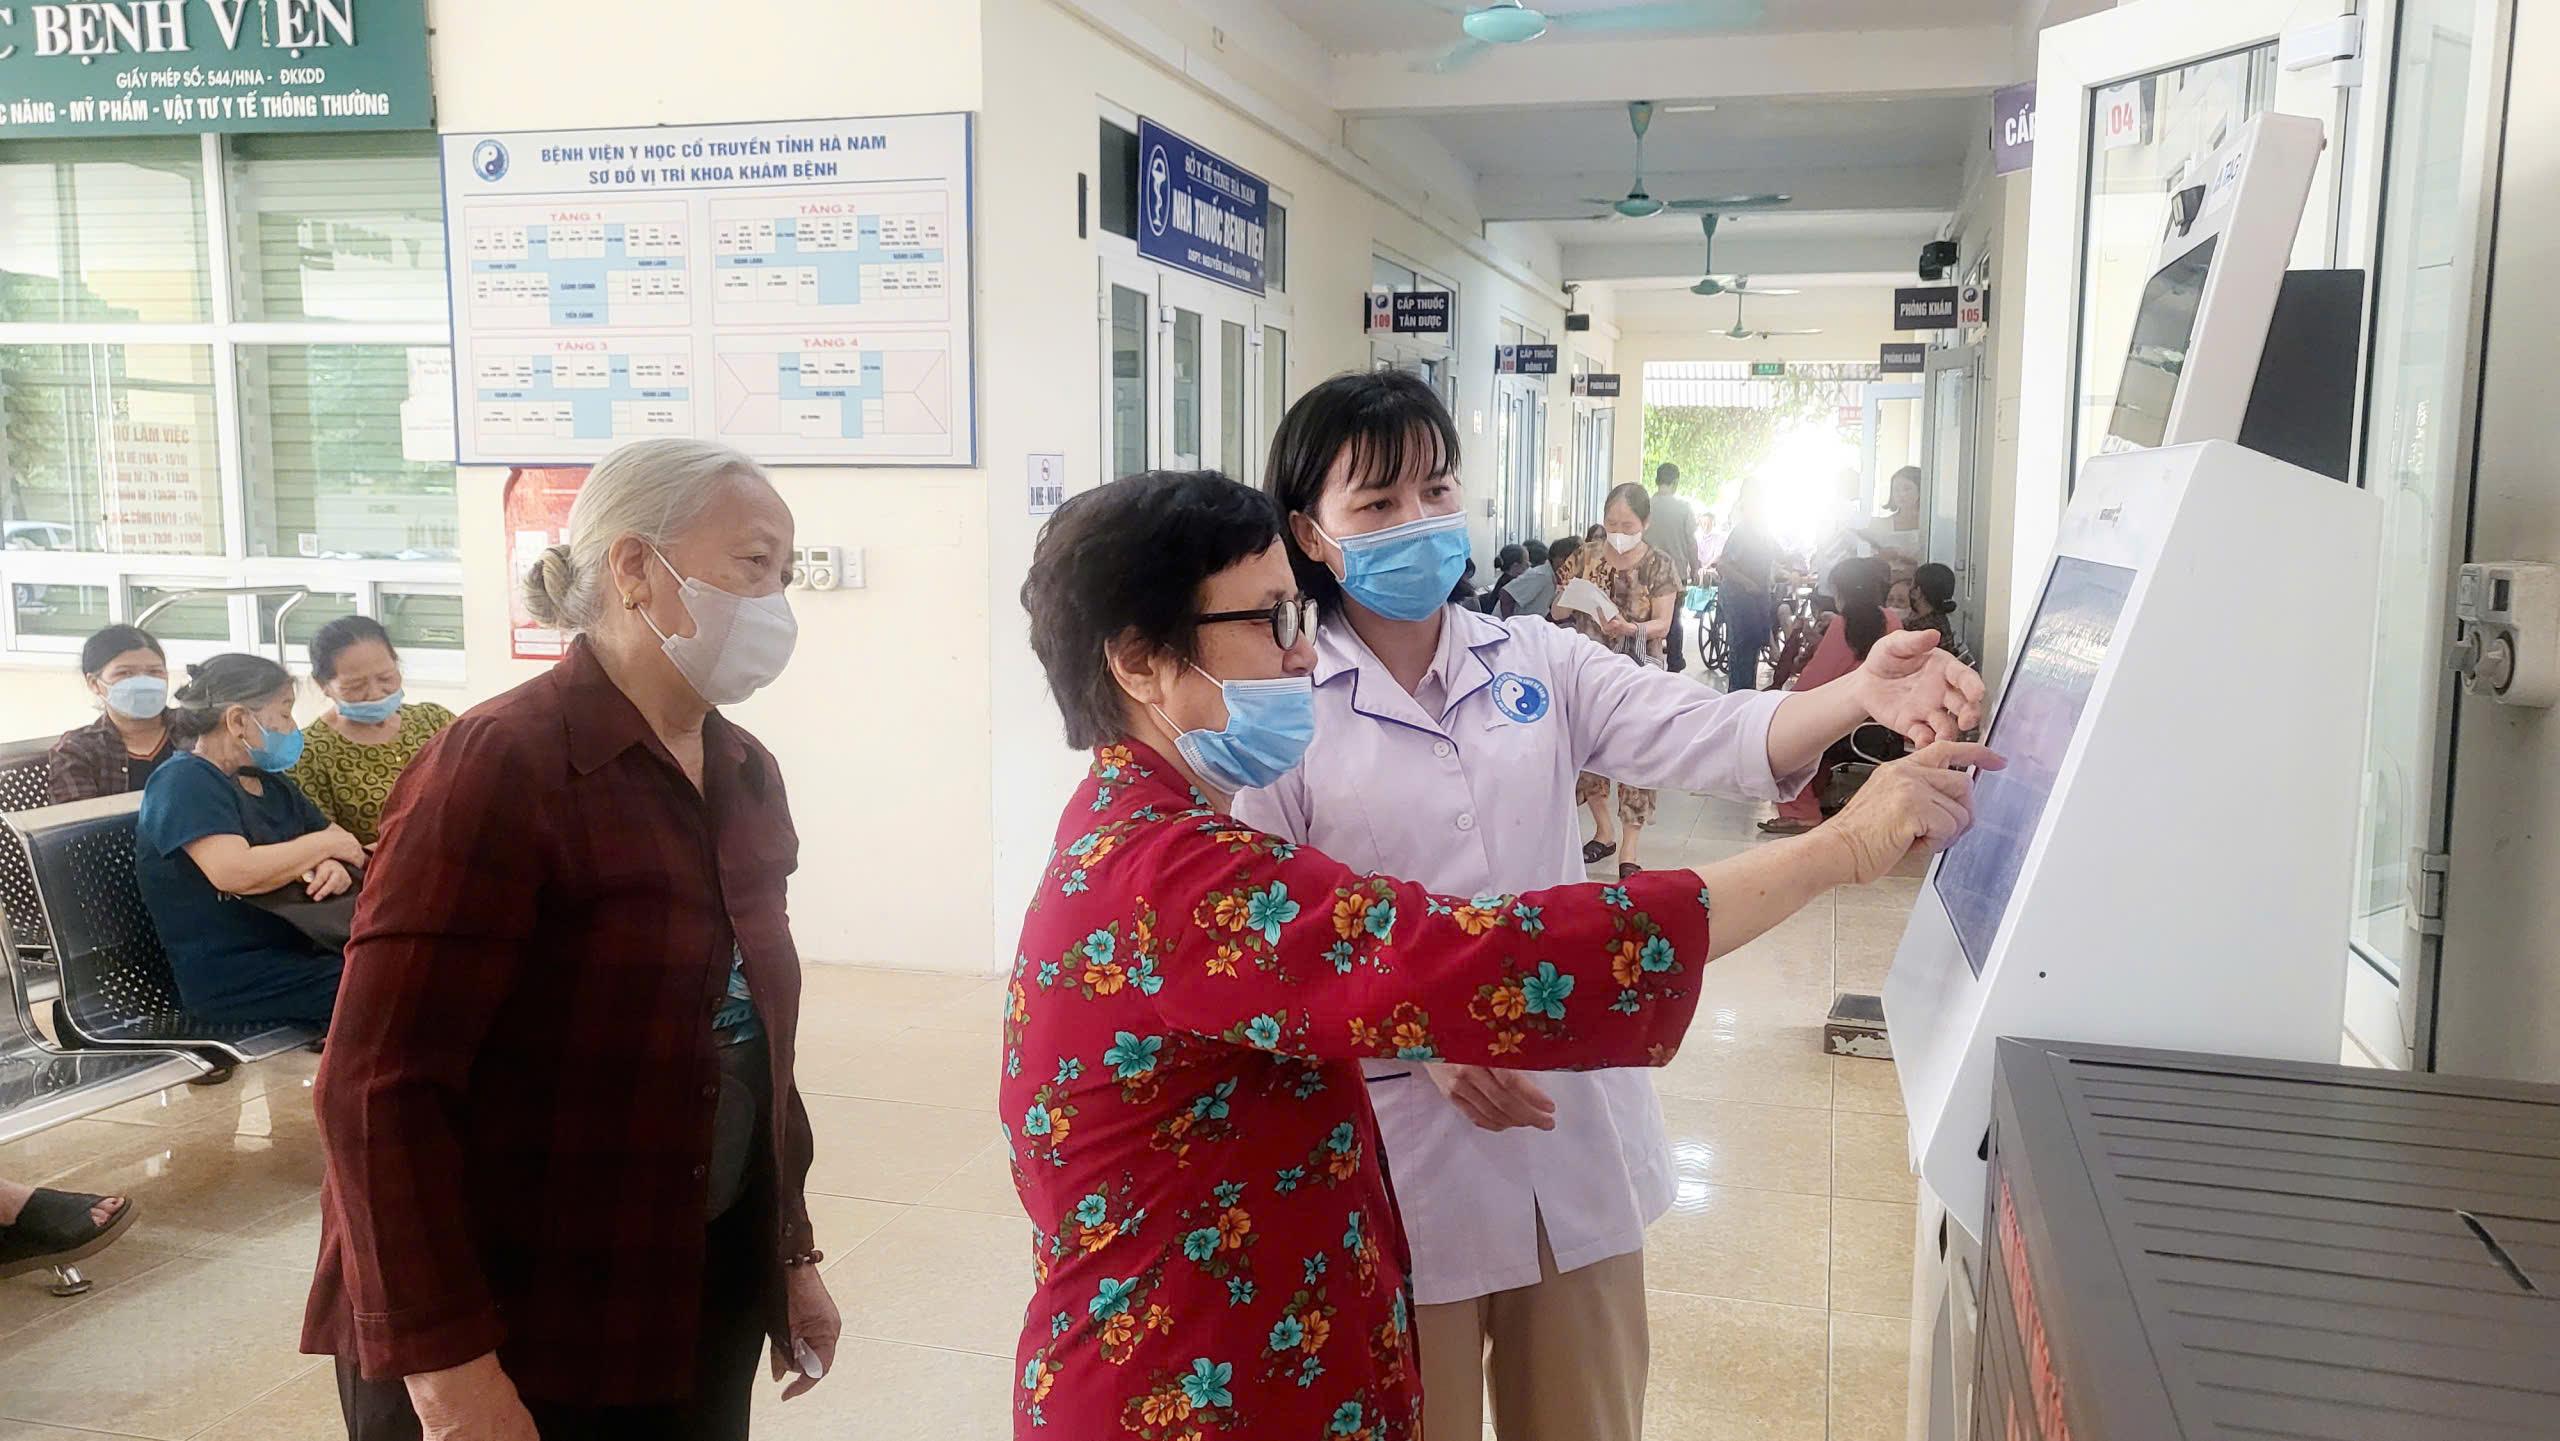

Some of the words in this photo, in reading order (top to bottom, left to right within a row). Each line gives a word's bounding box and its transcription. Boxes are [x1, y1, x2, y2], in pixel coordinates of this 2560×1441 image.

[116, 66, 149, 89] GIẤY
[151, 66, 182, 88] PHÉP
[183, 65, 206, 88] SỐ:
[208, 69, 265, 88] 544/HNA
[280, 67, 326, 85] ĐKKDD
[11, 98, 56, 124] NĂNG
[70, 96, 95, 122] MỸ
[99, 91, 149, 122] PHẨM
[163, 94, 194, 124] VẬT
[197, 96, 220, 120] TƯ
[221, 96, 233, 119] Y
[237, 89, 258, 118] TẾ
[261, 91, 318, 118] THÔNG
[321, 88, 390, 116] THƯỜNG
[541, 144, 584, 166] BỆNH
[588, 144, 625, 164] VIỆN
[631, 145, 639, 159] Y
[644, 143, 676, 162] HỌC
[776, 134, 815, 154] TỈNH
[820, 133, 842, 152] HÀ
[847, 135, 887, 150] NAM
[589, 170, 610, 185] SƠ
[641, 168, 656, 187] VỊ
[691, 166, 734, 182] KHOA
[739, 162, 788, 181] KHÁM
[793, 159, 838, 181] BỆNH
[1196, 160, 1203, 178] Y
[1203, 160, 1213, 184] TẾ
[846, 204, 855, 213] 2
[1172, 185, 1193, 234] NHÀ
[1194, 195, 1224, 246] THUỐC
[1223, 205, 1246, 258] BỆNH
[1397, 296, 1415, 310] CẤP
[1416, 295, 1445, 310] THUỐC
[1900, 298, 1928, 317] PHÒNG
[1928, 298, 1953, 316] KHÁM
[1374, 313, 1391, 328] 109
[1399, 314, 1417, 327] TÂN
[1961, 307, 1980, 323] 105
[601, 341, 608, 351] 3
[851, 337, 859, 348] 4
